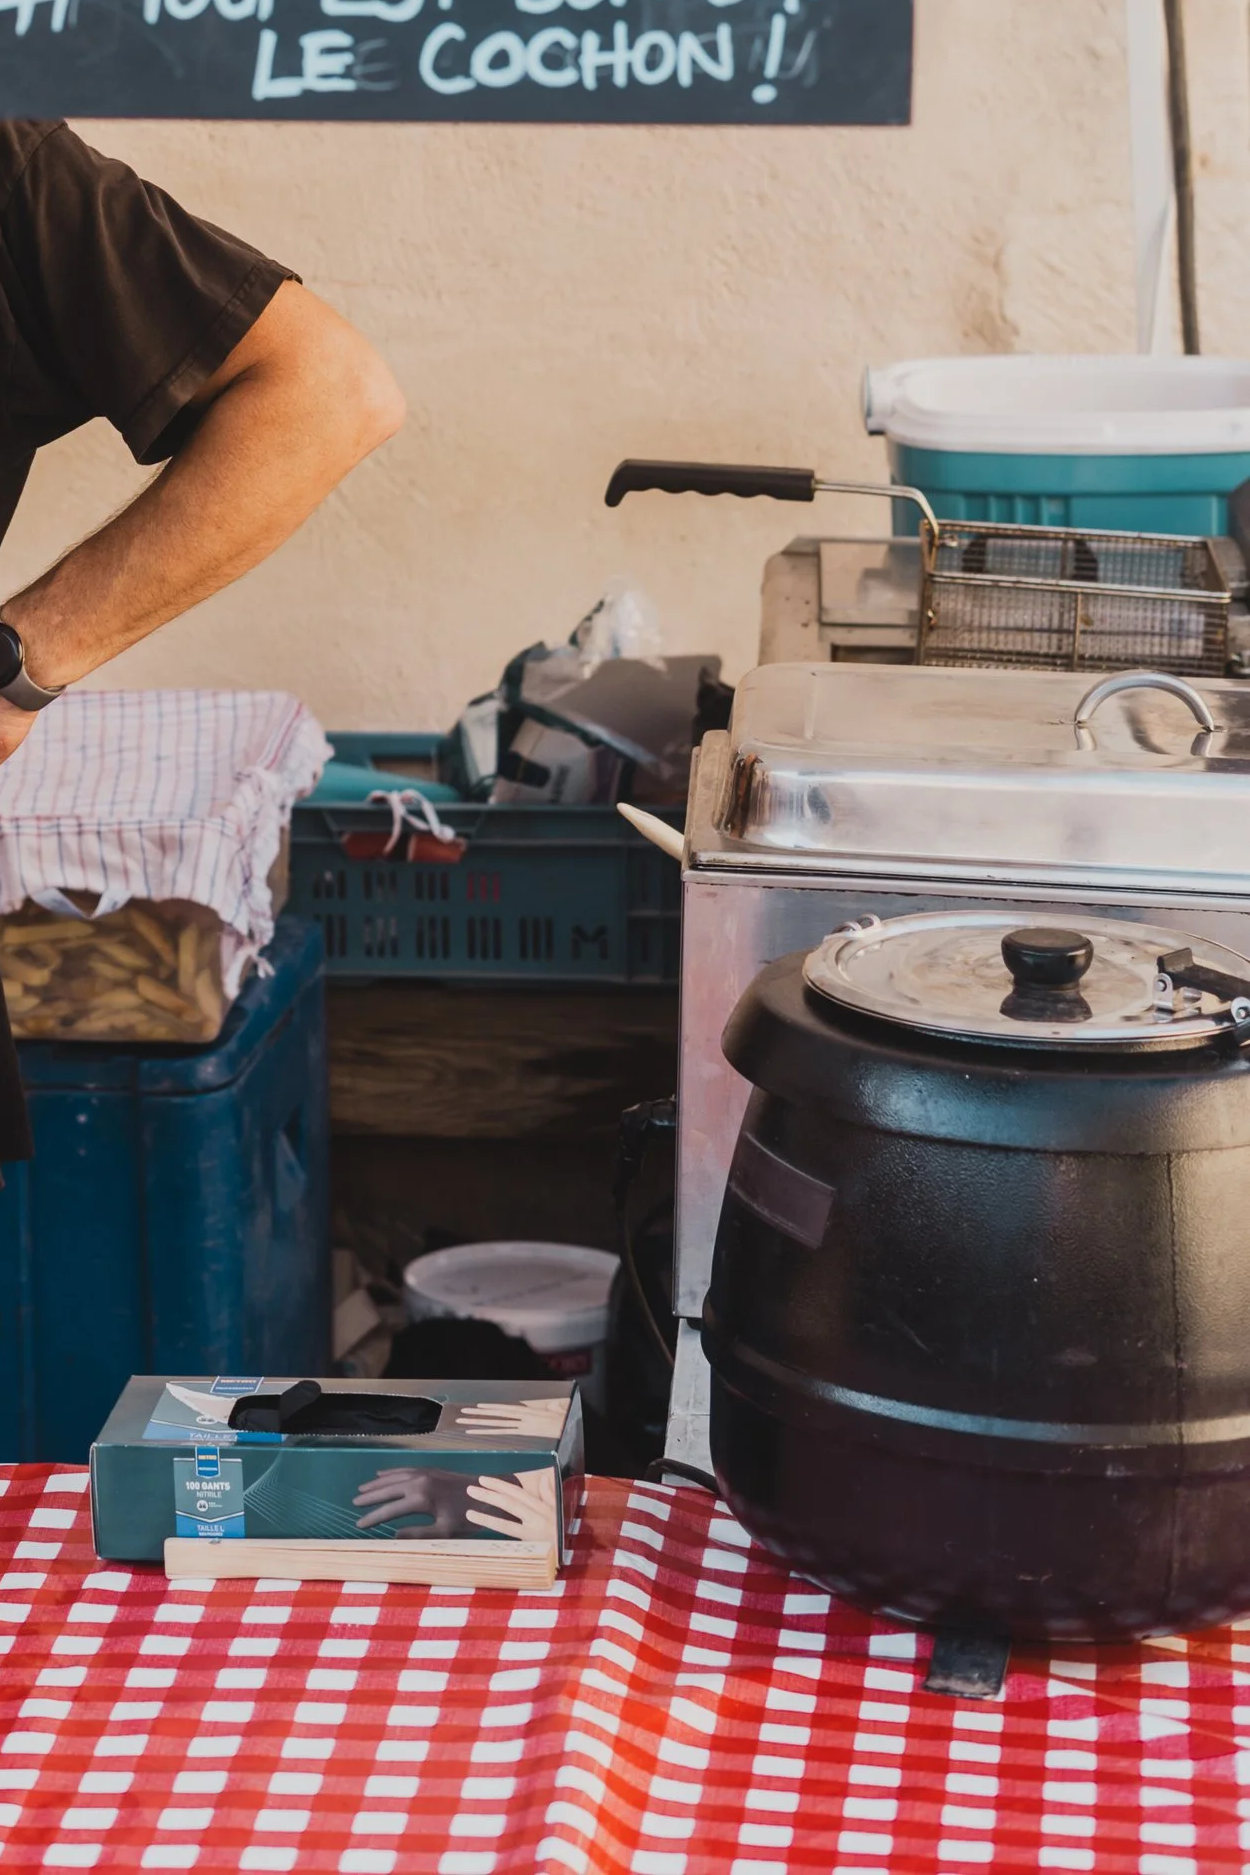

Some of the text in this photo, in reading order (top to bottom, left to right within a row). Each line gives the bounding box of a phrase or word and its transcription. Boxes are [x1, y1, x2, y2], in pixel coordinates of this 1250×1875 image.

[252, 27, 355, 100] LE
[185, 1481, 231, 1491] 100 GANTS
[196, 1490, 222, 1498] NITRILE
